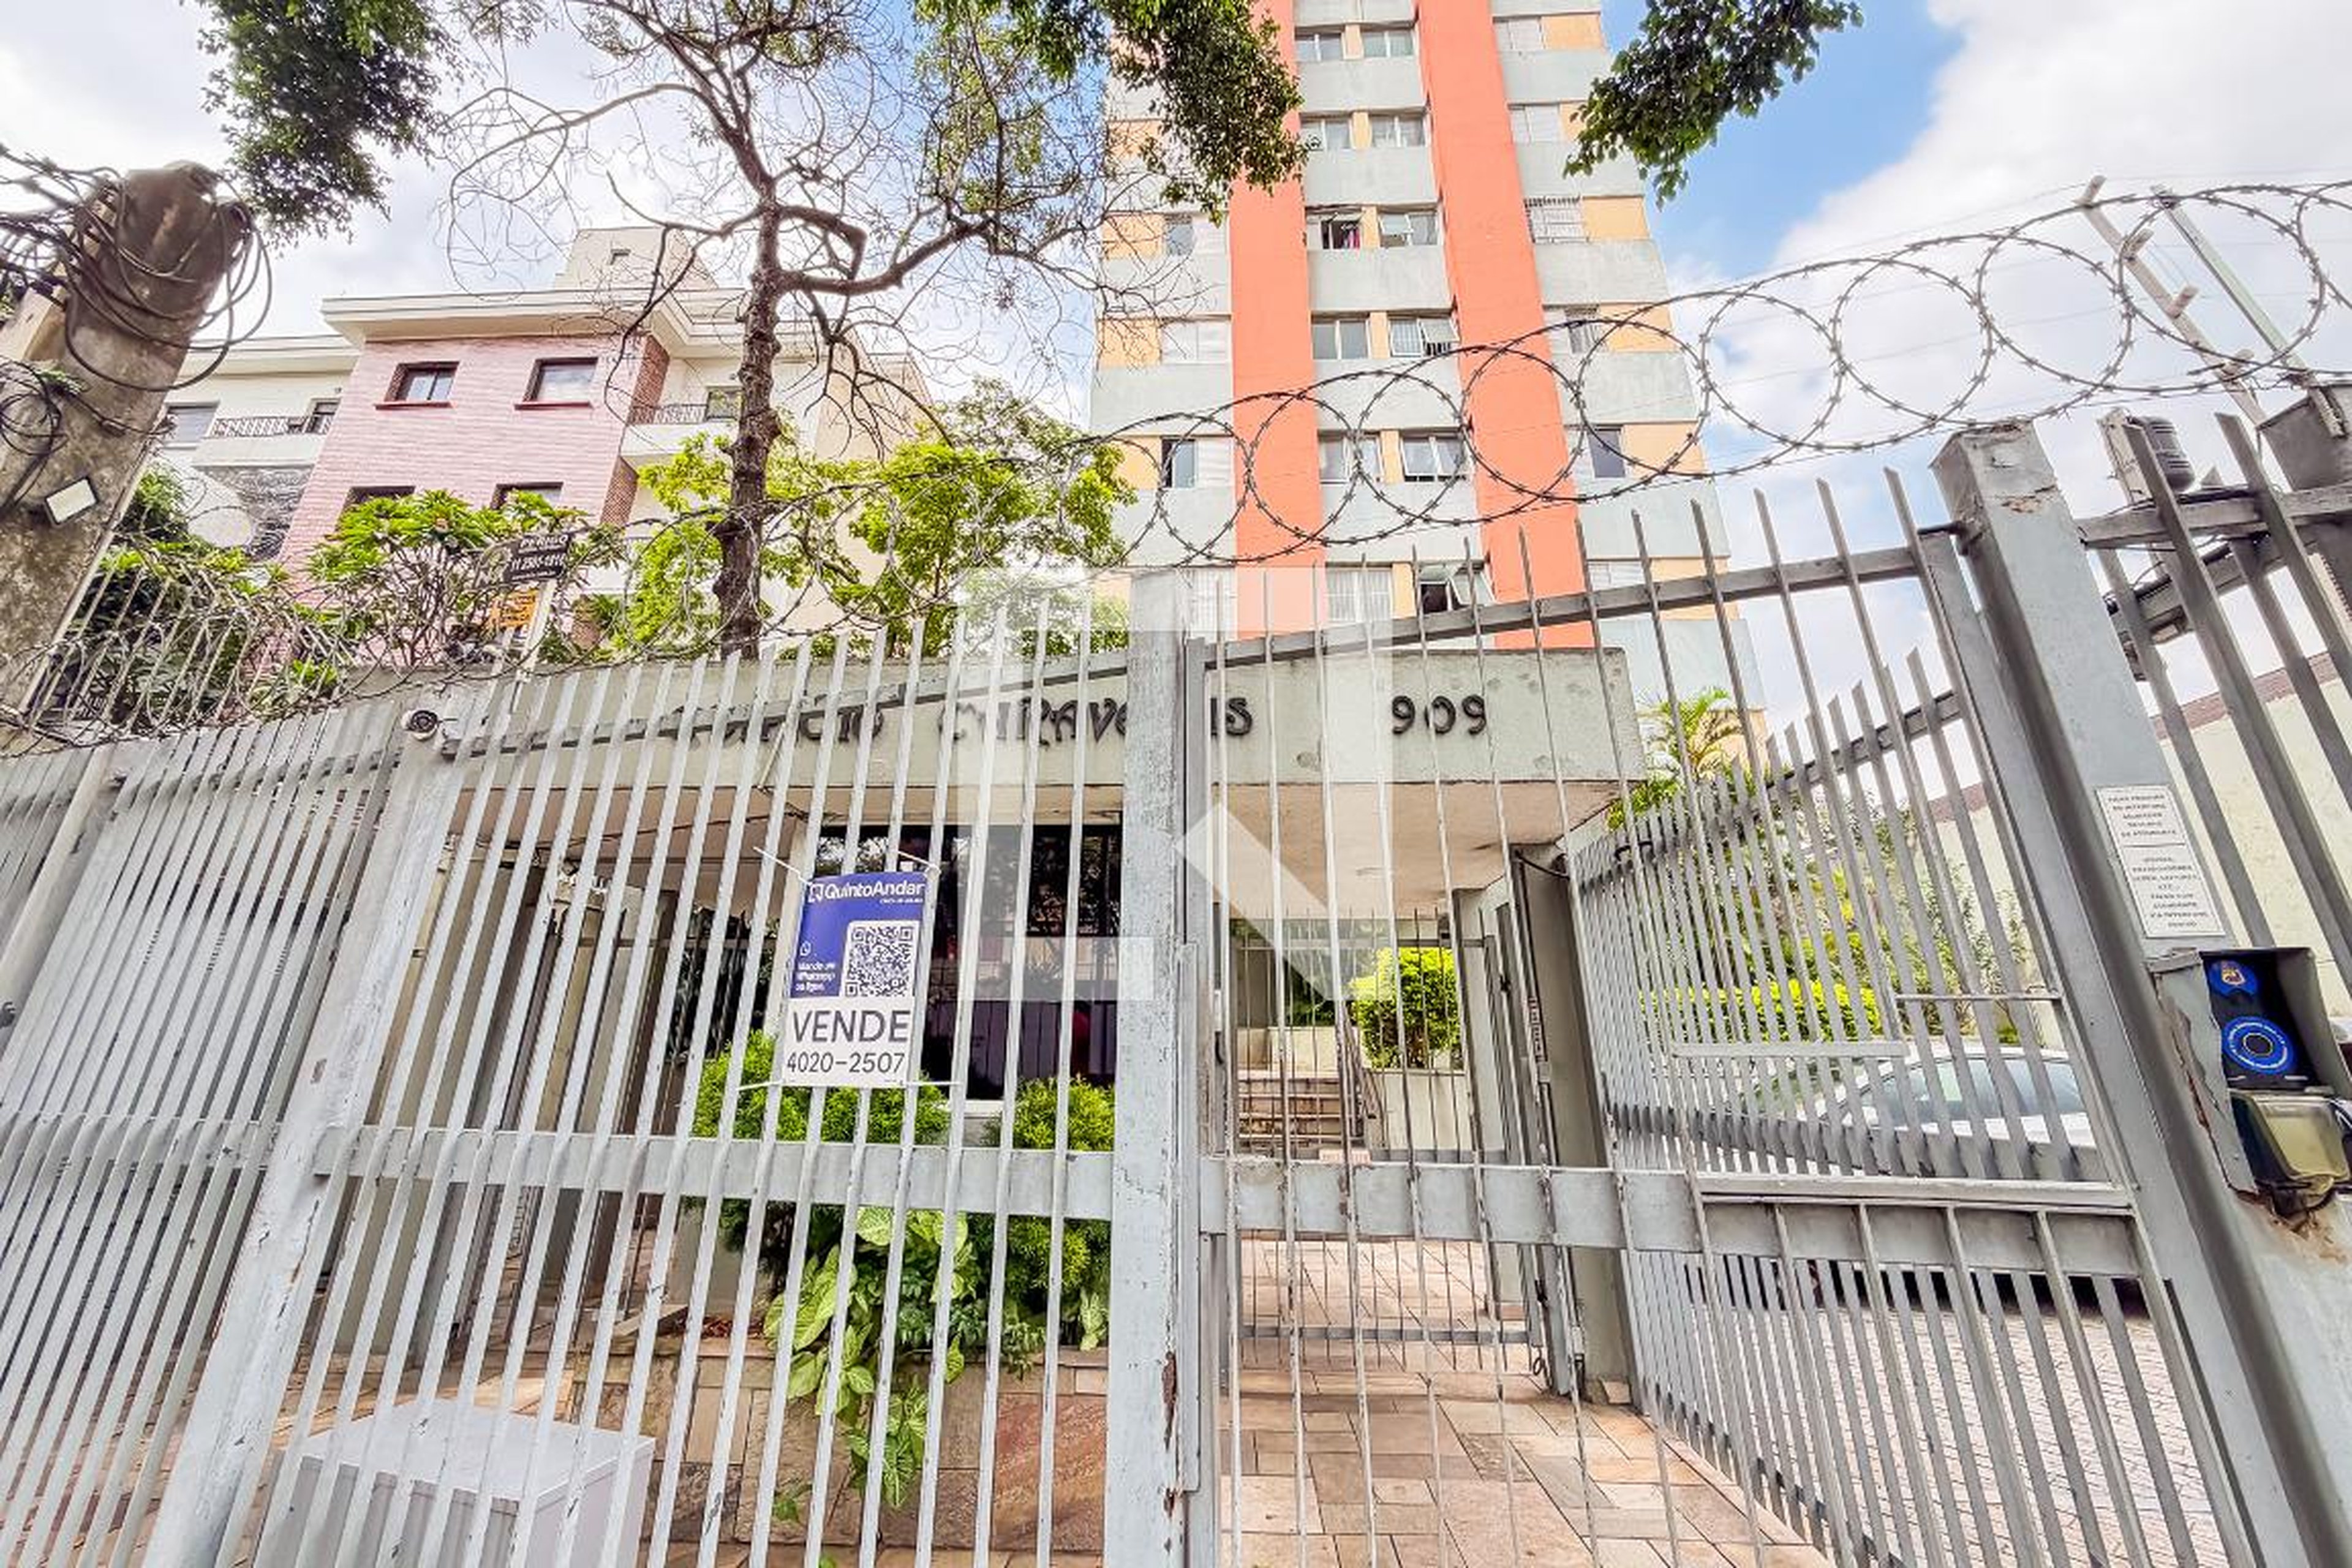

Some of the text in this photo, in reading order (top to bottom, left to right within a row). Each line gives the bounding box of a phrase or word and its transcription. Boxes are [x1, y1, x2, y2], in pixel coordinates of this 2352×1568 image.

[1392, 695, 1487, 734] 909
[824, 880, 925, 899] QuintoAndar
[793, 1010, 911, 1042] VENDE
[786, 1051, 905, 1073] 4020-2507
